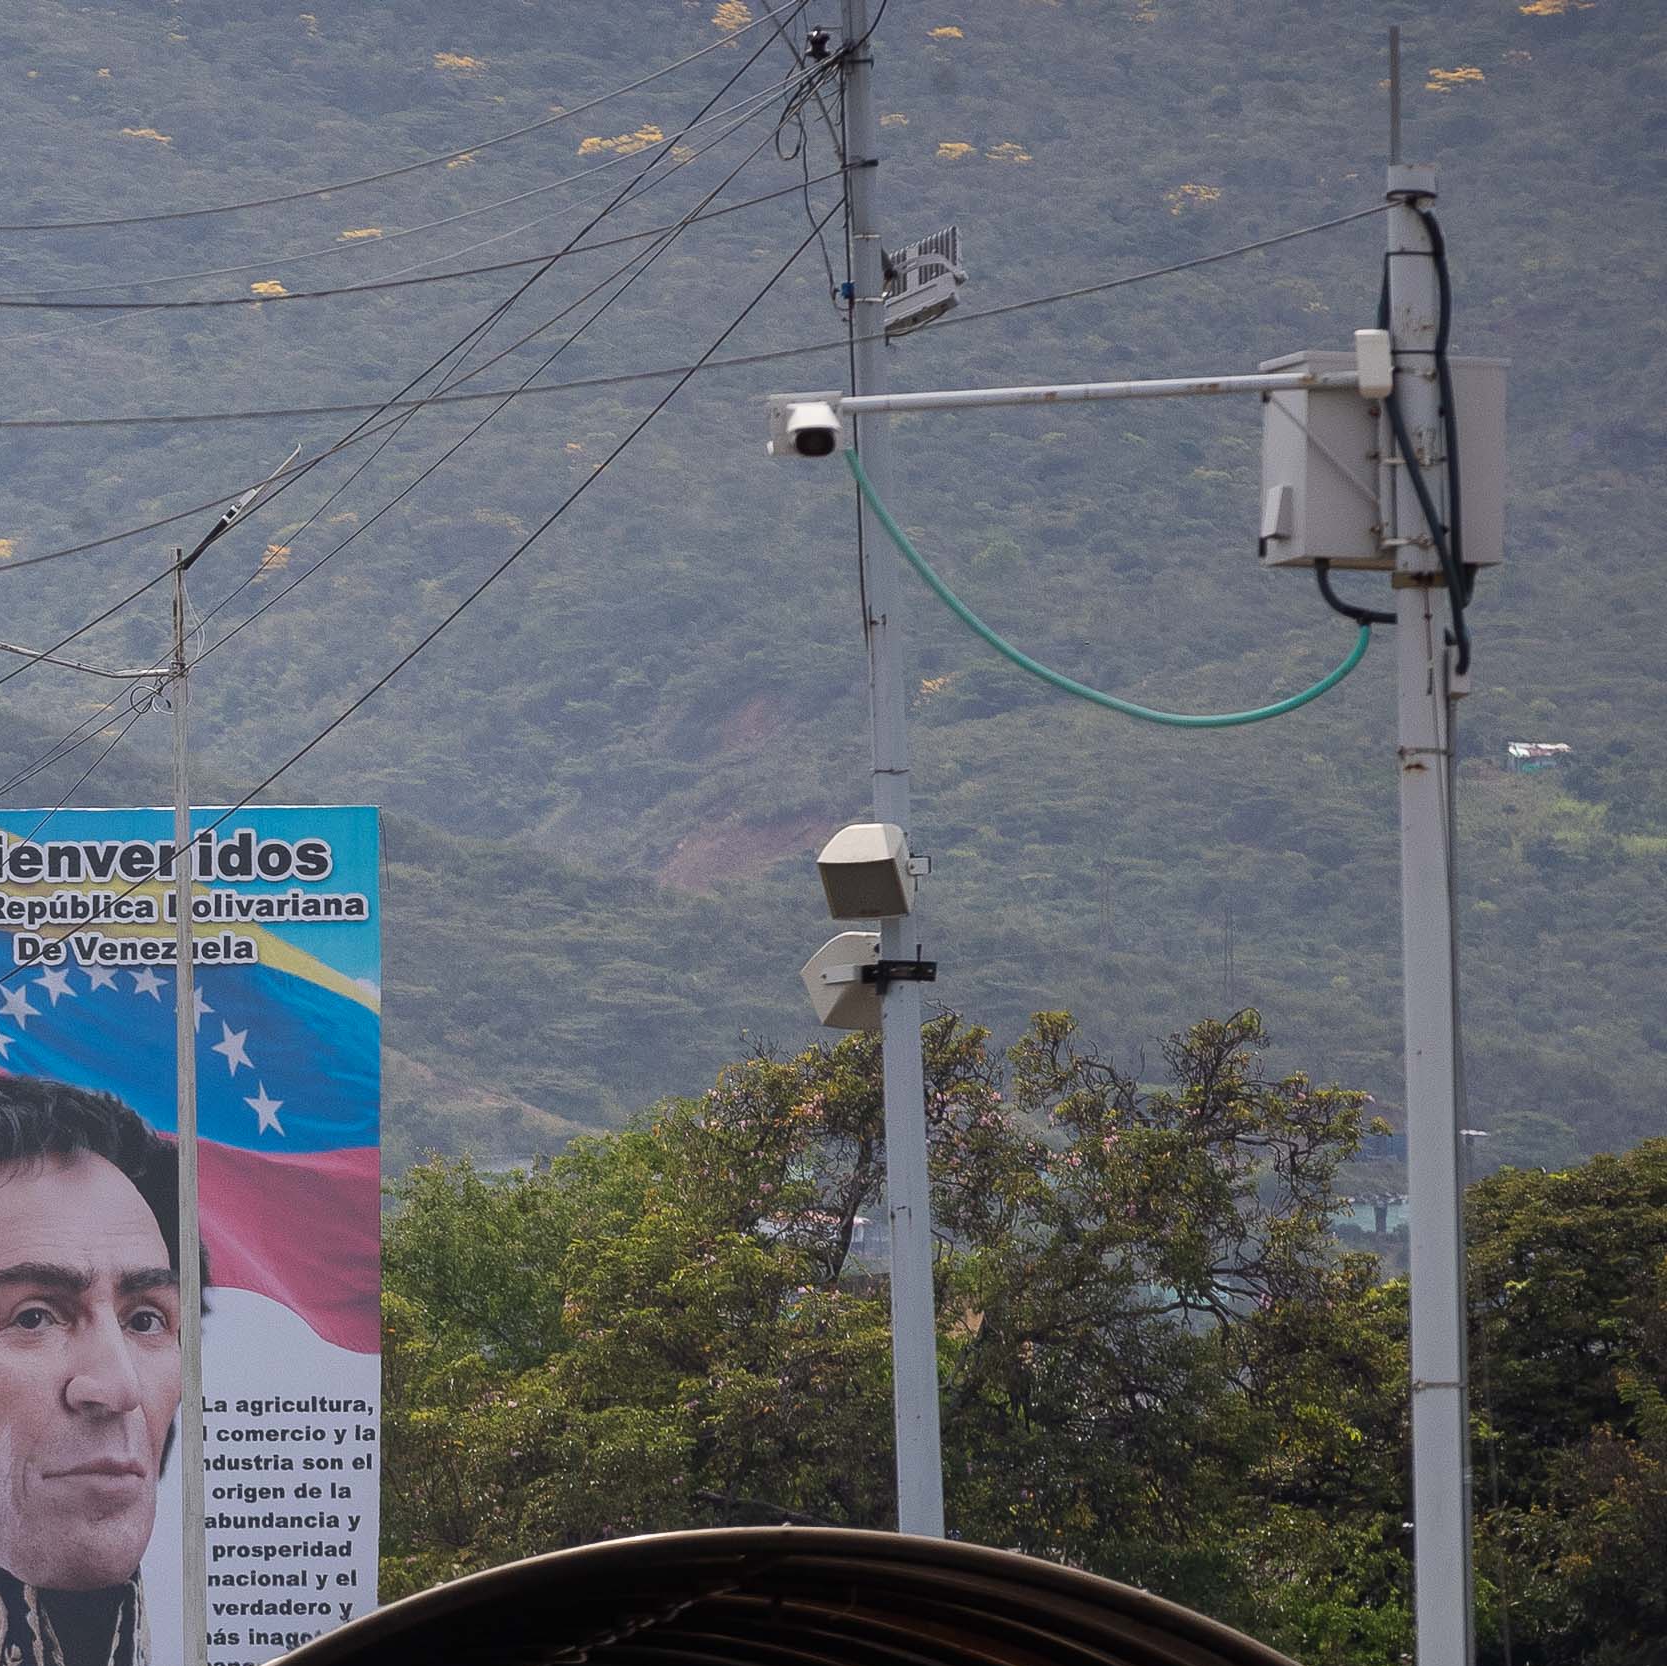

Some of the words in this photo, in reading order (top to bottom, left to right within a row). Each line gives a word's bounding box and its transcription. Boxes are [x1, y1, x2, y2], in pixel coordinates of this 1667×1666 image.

[18, 937, 62, 961] De
[202, 1396, 227, 1413] La
[236, 1396, 373, 1416] agricultura,
[216, 1426, 326, 1441] comercio
[334, 1428, 347, 1445] y
[355, 1424, 376, 1441] la
[204, 1454, 294, 1471] ndustria
[302, 1457, 343, 1470] son
[352, 1453, 372, 1470] el
[212, 1483, 285, 1503] origen
[294, 1483, 322, 1499] de
[330, 1482, 351, 1499] la
[204, 1512, 339, 1529] abundancia
[348, 1515, 361, 1532] y
[212, 1541, 352, 1562] prosperidad
[208, 1570, 307, 1587] nacional
[315, 1574, 328, 1590] y
[336, 1569, 357, 1586] el
[212, 1599, 331, 1616] verdadero
[339, 1602, 353, 1621] y
